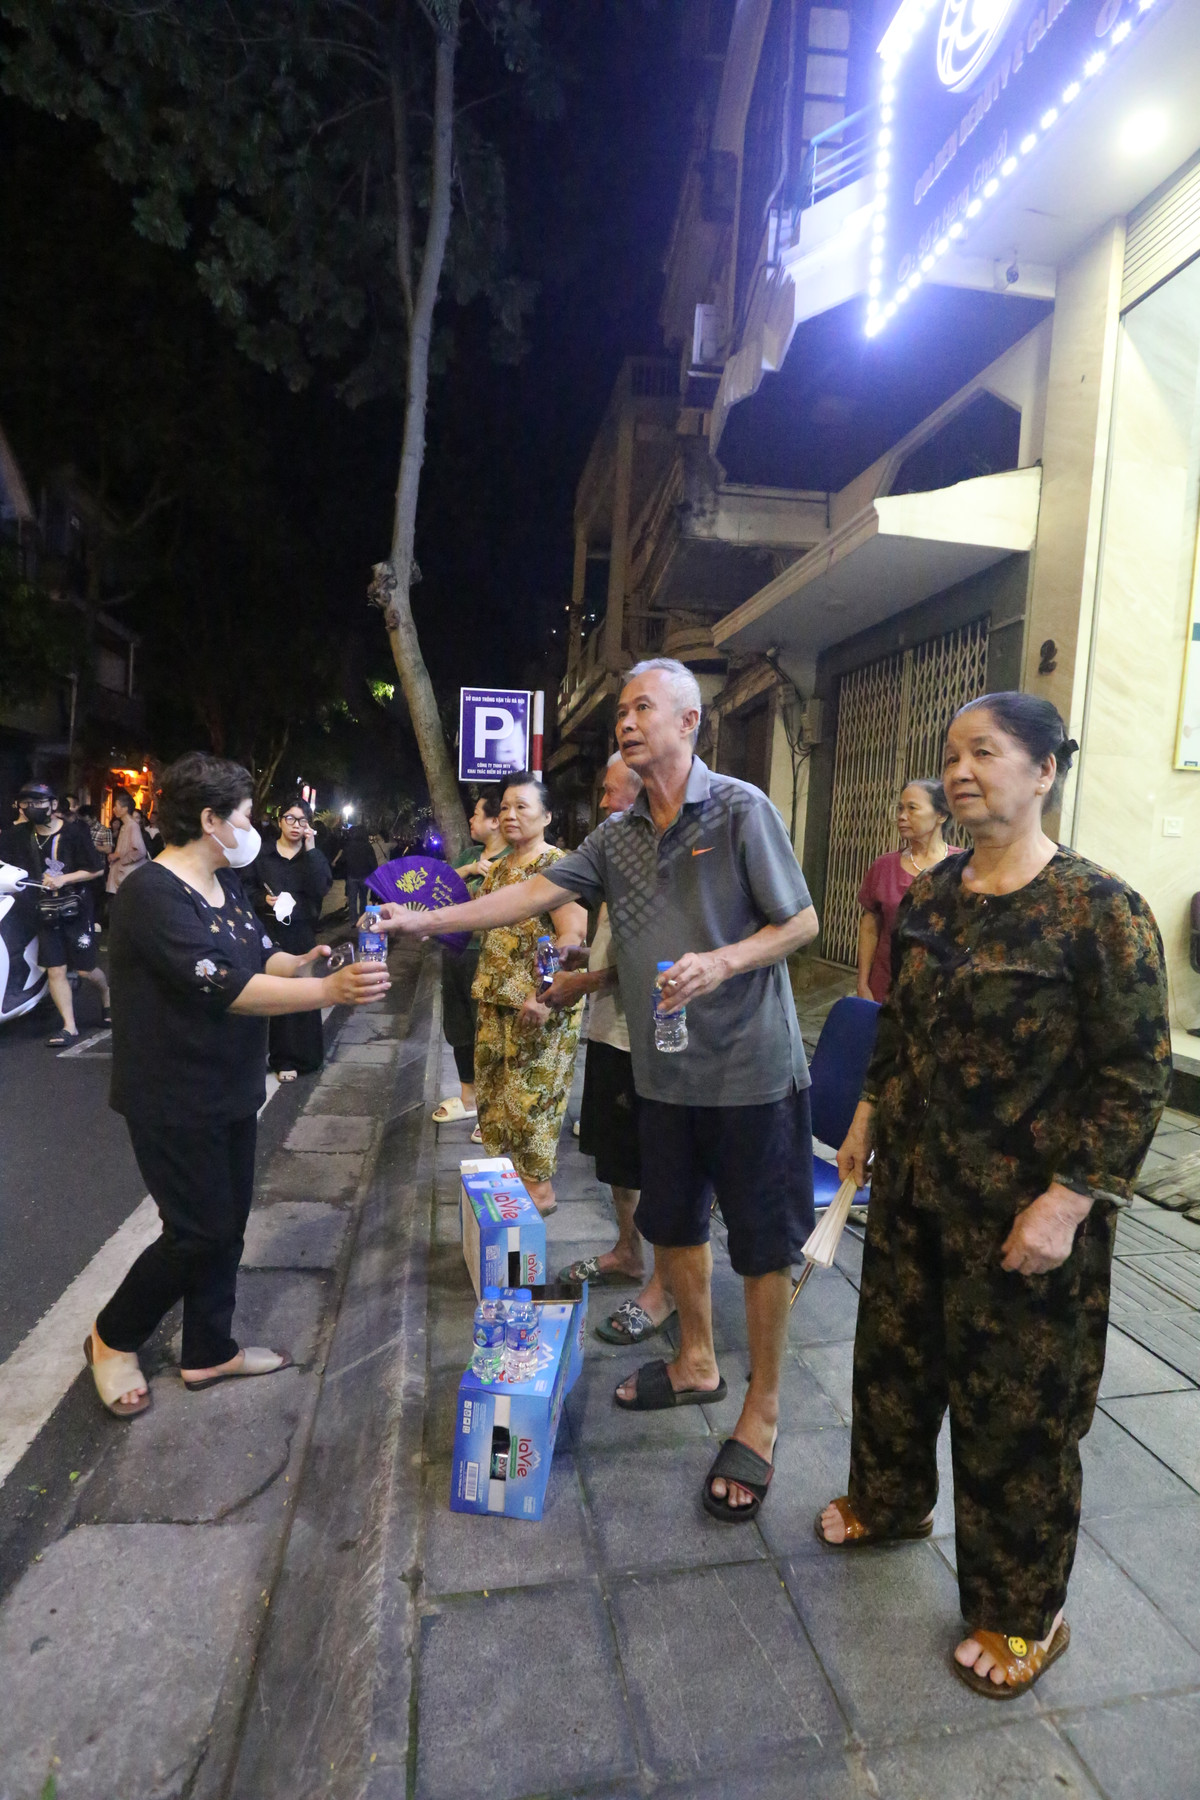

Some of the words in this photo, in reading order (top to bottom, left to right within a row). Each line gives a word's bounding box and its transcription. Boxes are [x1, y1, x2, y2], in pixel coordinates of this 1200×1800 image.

[475, 706, 515, 758] P
[493, 1192, 522, 1220] laVie
[527, 1253, 537, 1283] laVie
[517, 1438, 533, 1477] laVie
